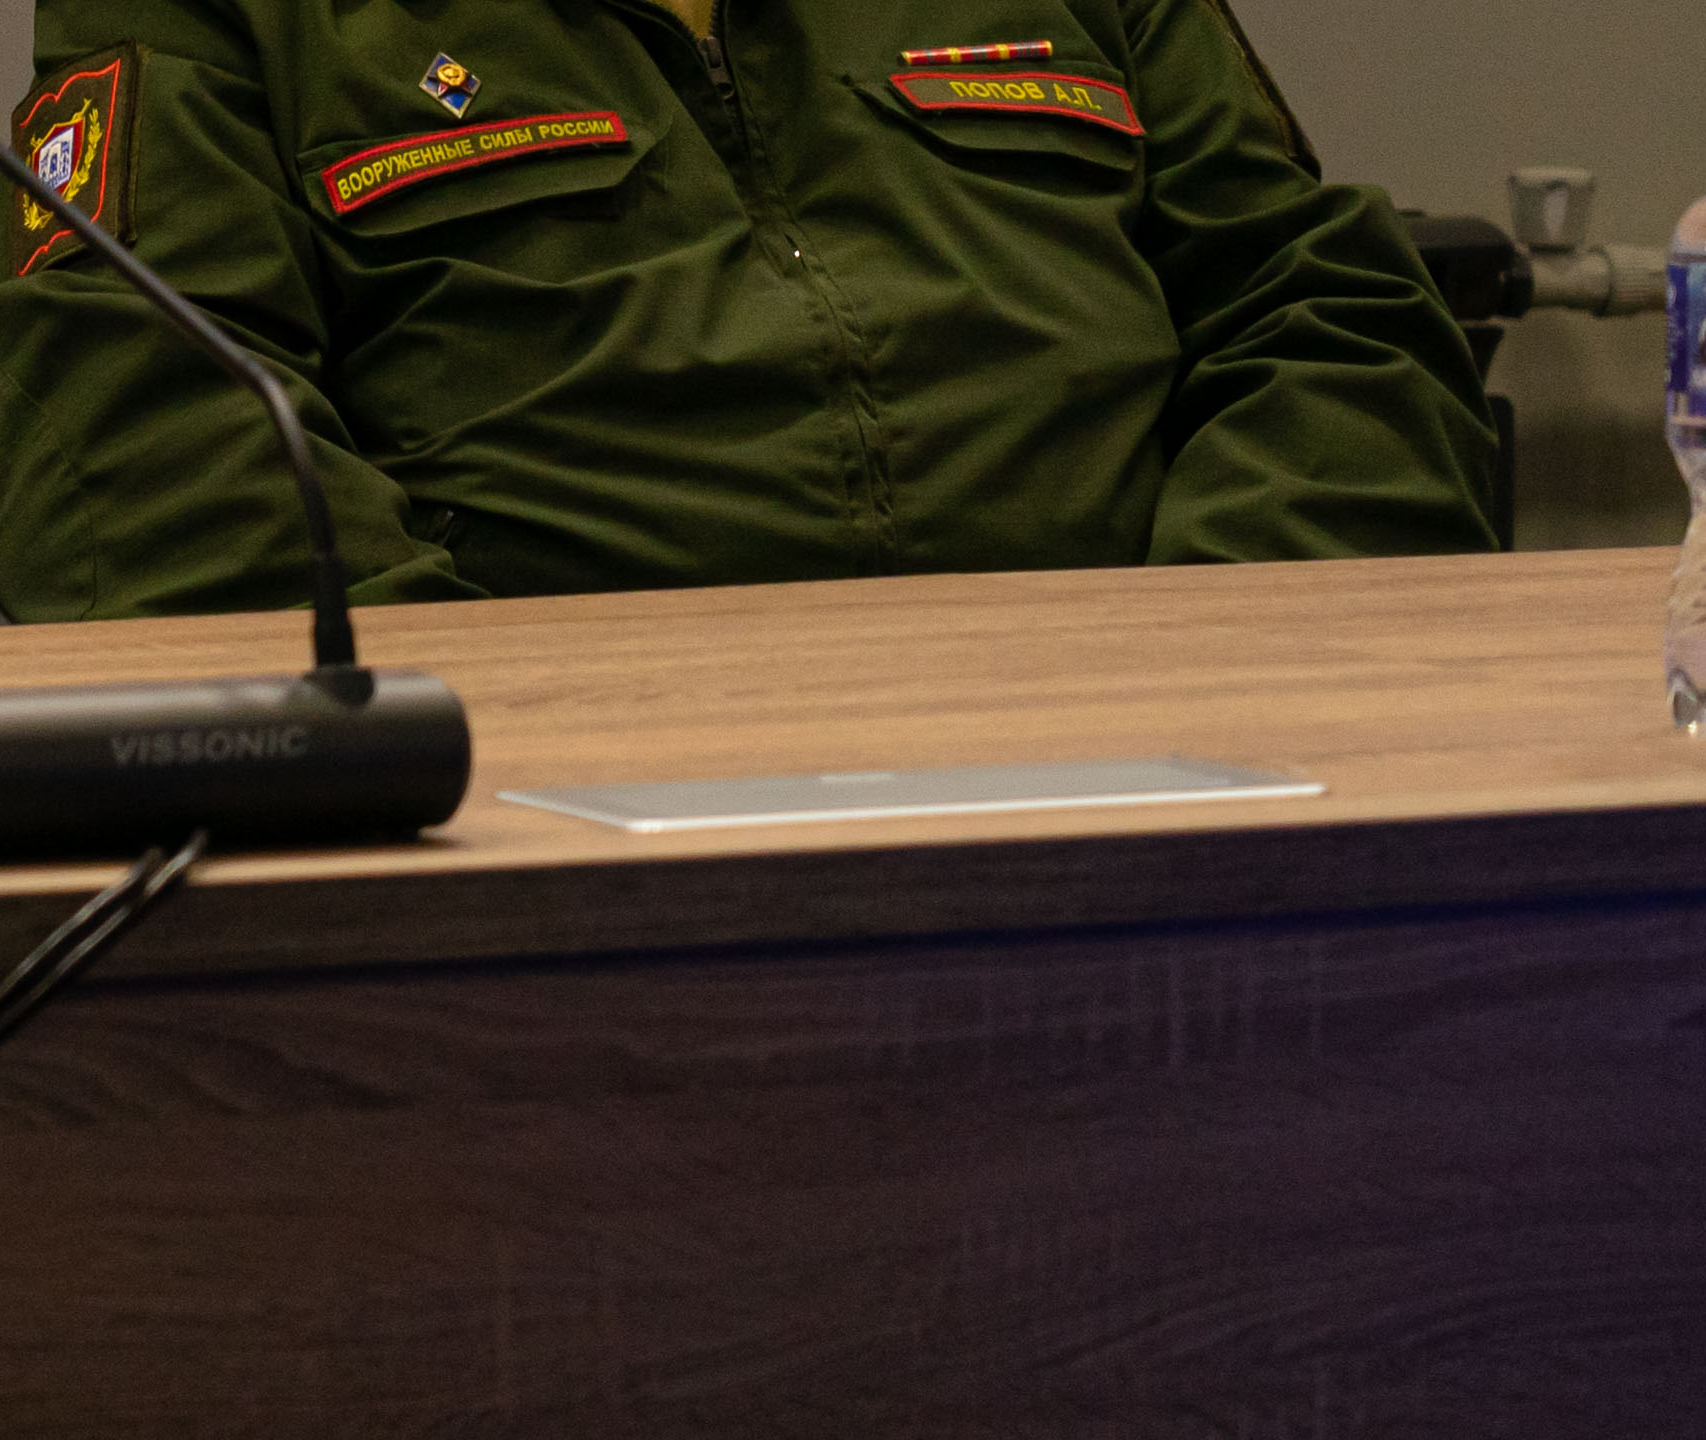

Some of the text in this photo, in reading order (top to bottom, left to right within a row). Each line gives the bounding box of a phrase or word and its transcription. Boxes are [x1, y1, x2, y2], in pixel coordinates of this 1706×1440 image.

[949, 80, 1045, 100] ПОПОВ
[337, 119, 615, 201] ВООРУЖЕННЫЕ СИЛЫ РОССИИ
[110, 725, 310, 766] VISSONIC
